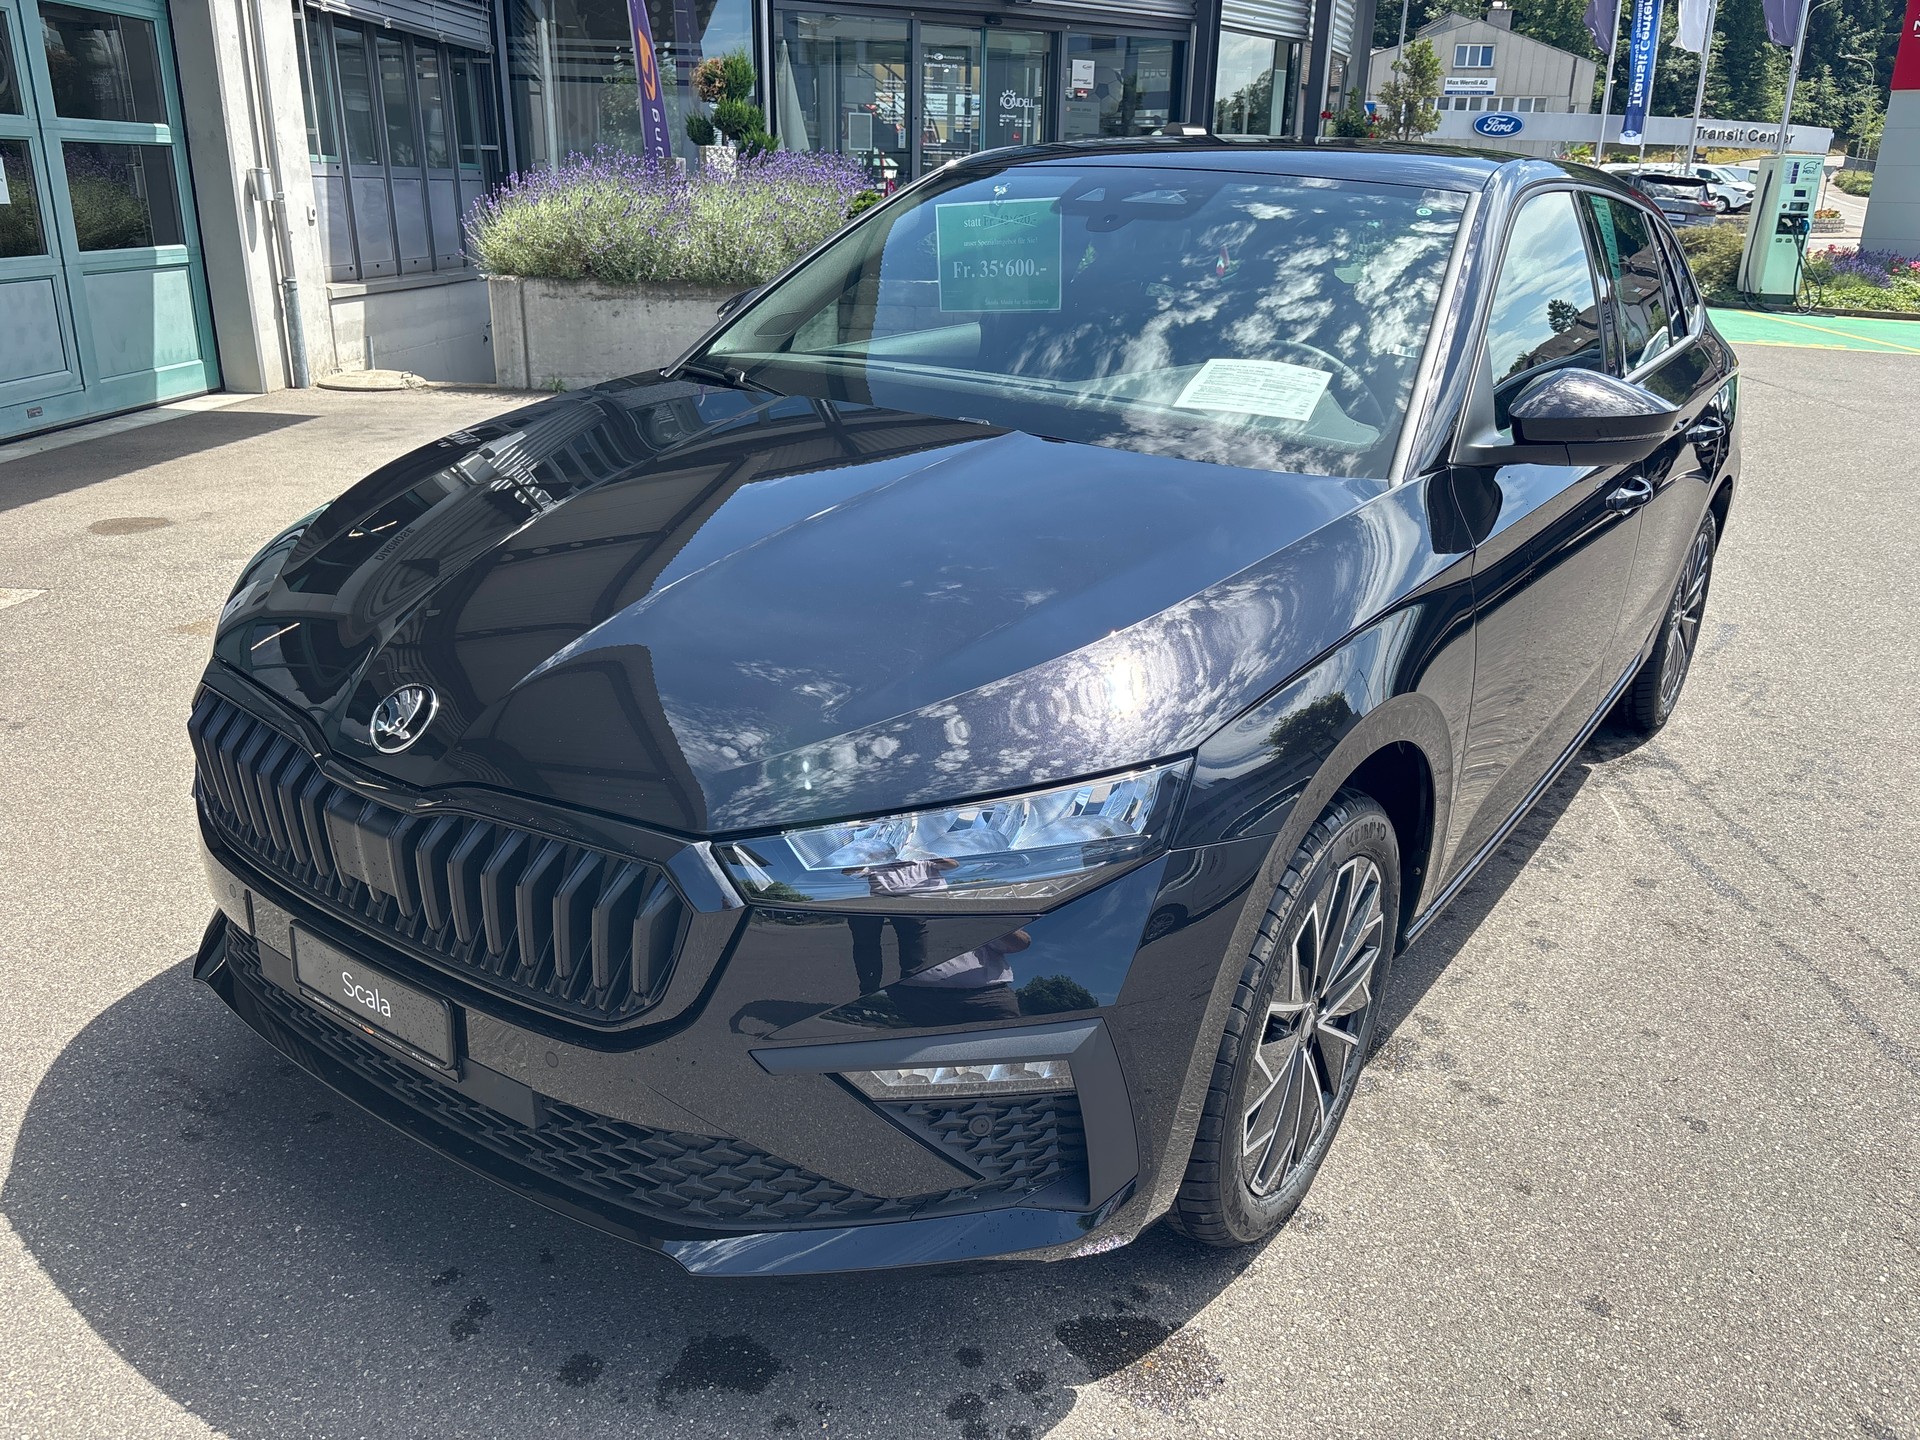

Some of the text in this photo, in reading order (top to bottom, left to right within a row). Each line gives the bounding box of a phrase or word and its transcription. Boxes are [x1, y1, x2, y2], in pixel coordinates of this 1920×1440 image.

[652, 108, 665, 159] üng
[1483, 116, 1516, 132] Ford
[1696, 126, 1744, 142] Transit
[963, 218, 981, 228] statt
[953, 258, 1047, 279] Fr. 35'600.-
[1346, 821, 1386, 848] KUMHO
[342, 971, 392, 1018] Scala
